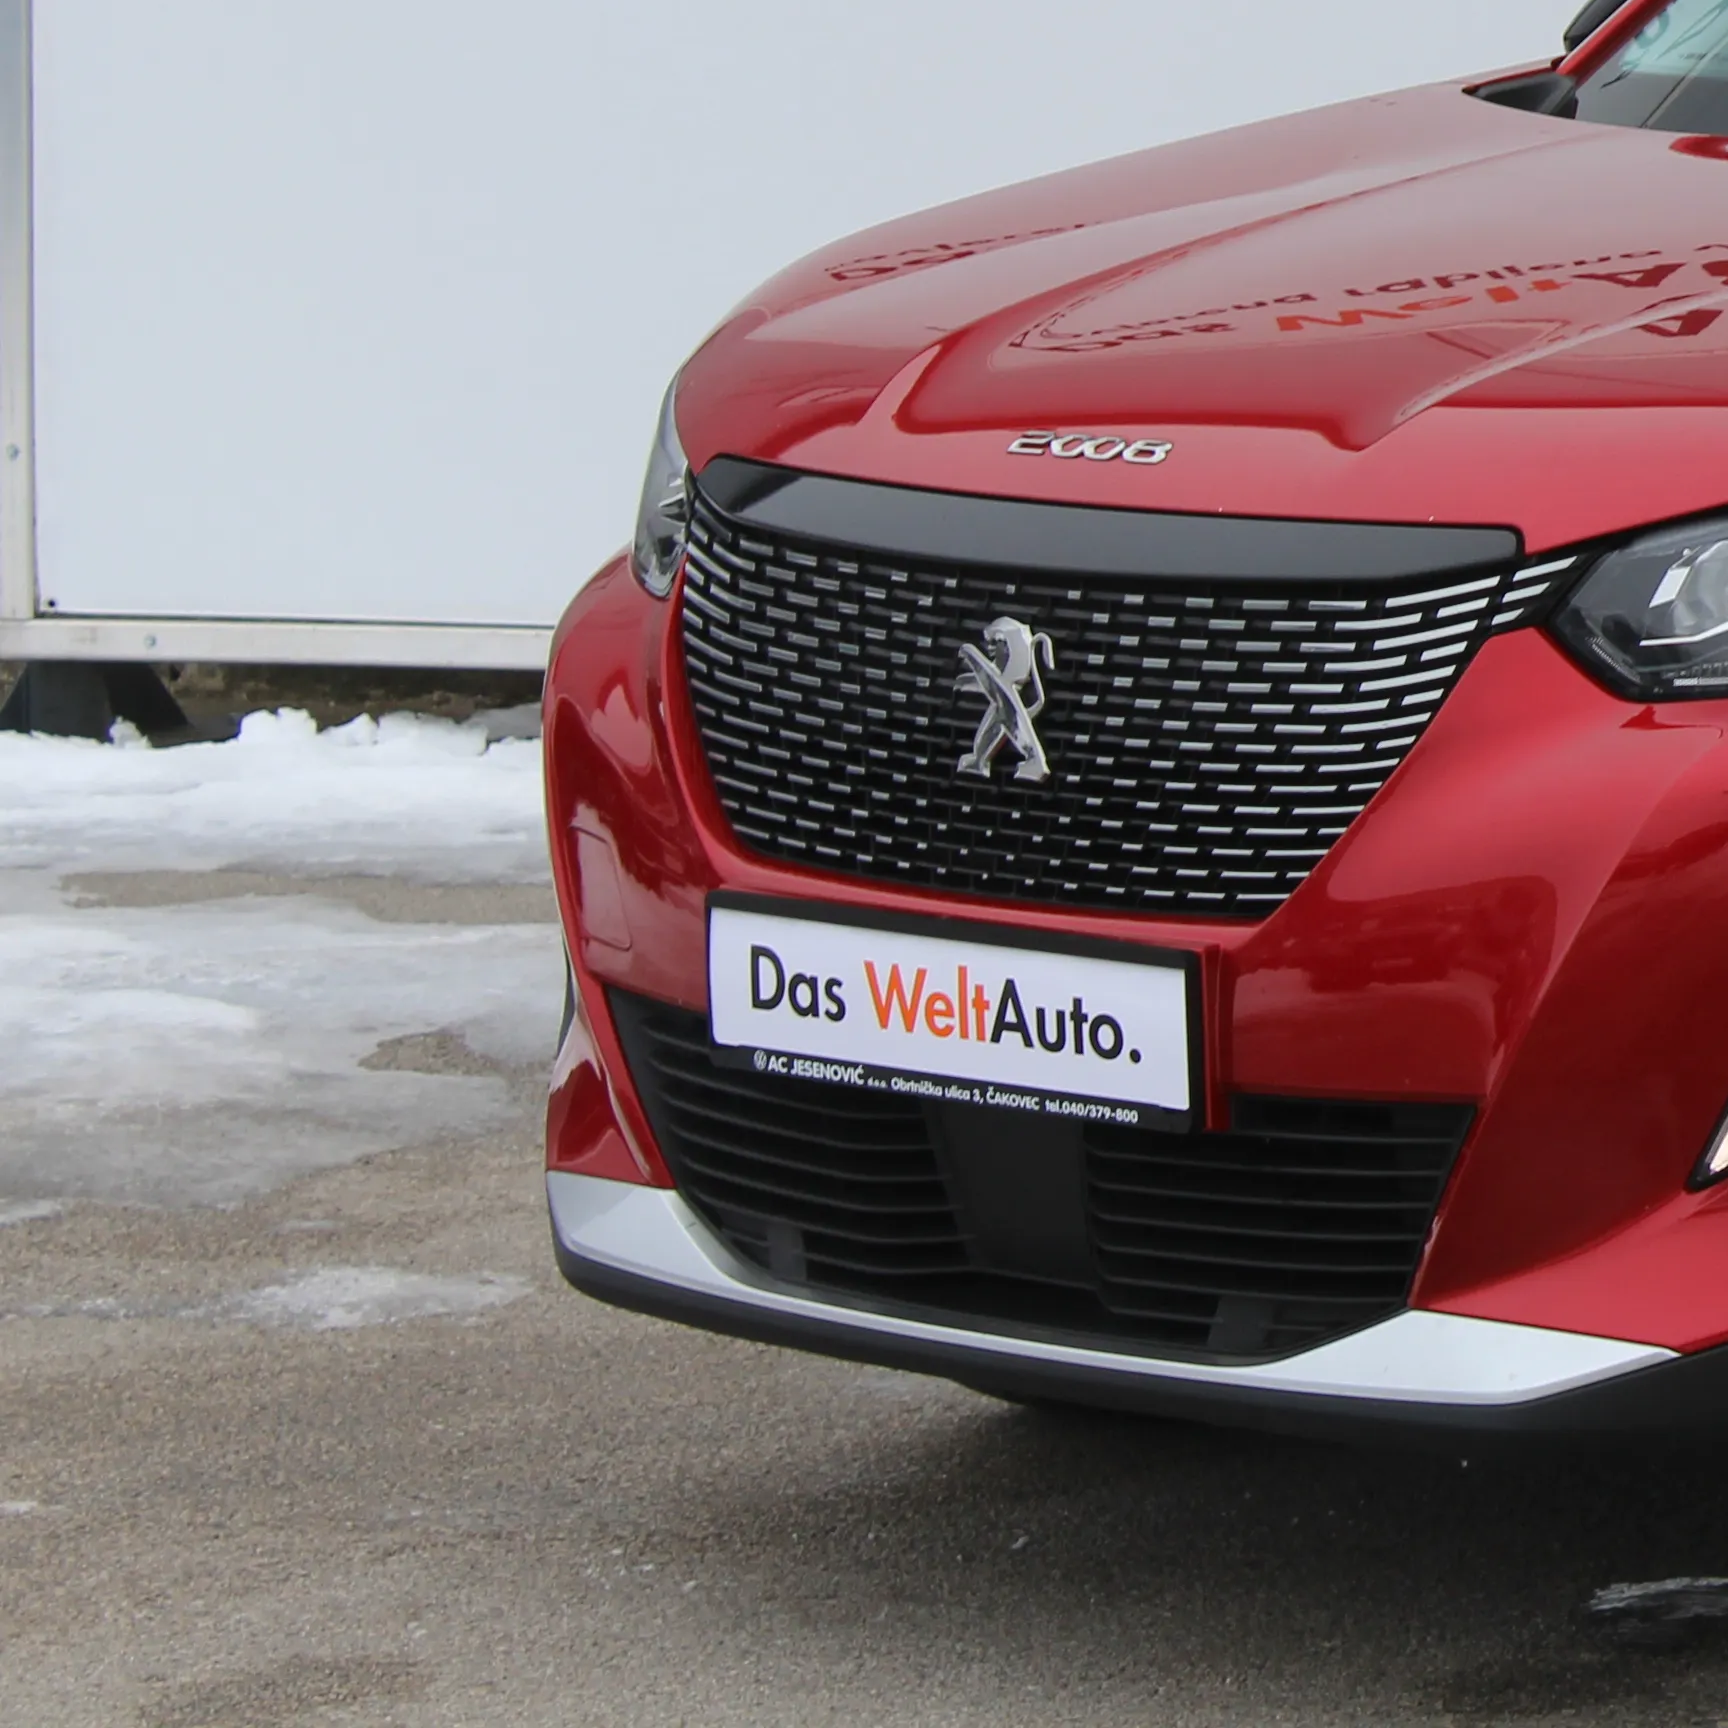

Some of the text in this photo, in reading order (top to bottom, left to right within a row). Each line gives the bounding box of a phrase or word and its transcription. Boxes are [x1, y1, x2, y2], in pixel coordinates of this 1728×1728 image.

[1006, 429, 1174, 465] 2008
[750, 943, 1143, 1065] Das WeltAuto.
[768, 1055, 789, 1074] AC
[790, 1057, 865, 1086] JESENOVIĆ
[945, 1084, 971, 1102] ulica
[985, 1085, 1041, 1111] ČAKOVEC
